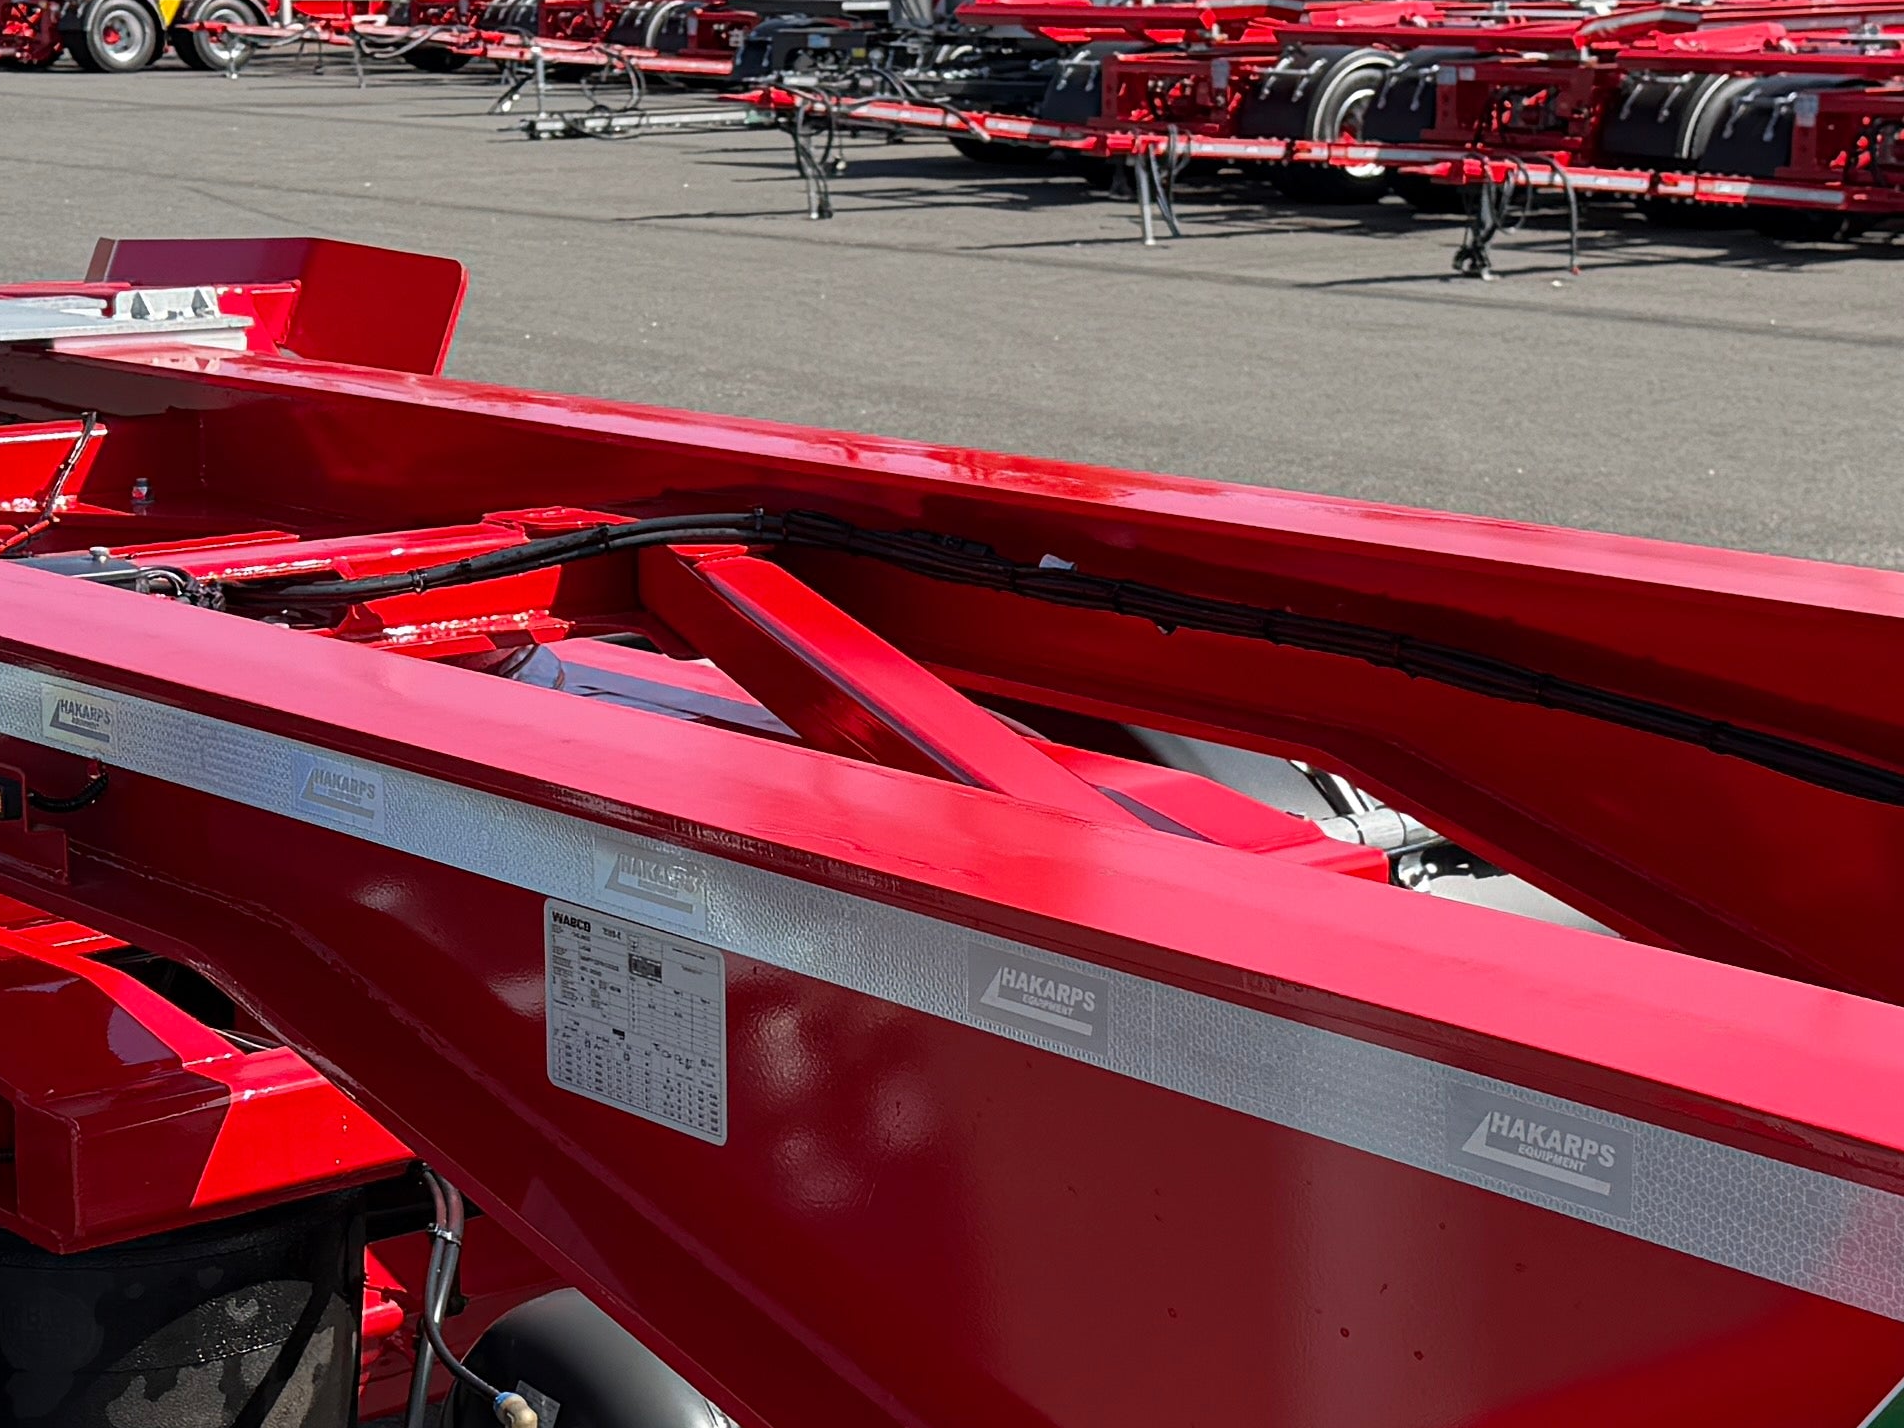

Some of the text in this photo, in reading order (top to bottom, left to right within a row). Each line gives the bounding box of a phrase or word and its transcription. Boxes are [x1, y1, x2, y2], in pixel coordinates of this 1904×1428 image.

[59, 699, 112, 725] HAKARPS
[312, 768, 375, 799] HAKARPS
[552, 911, 591, 932] WABCO
[1001, 967, 1096, 1012] HAKARPS
[1490, 1111, 1616, 1168] HAKARPS
[1517, 1144, 1588, 1172] EQUIPMENT
